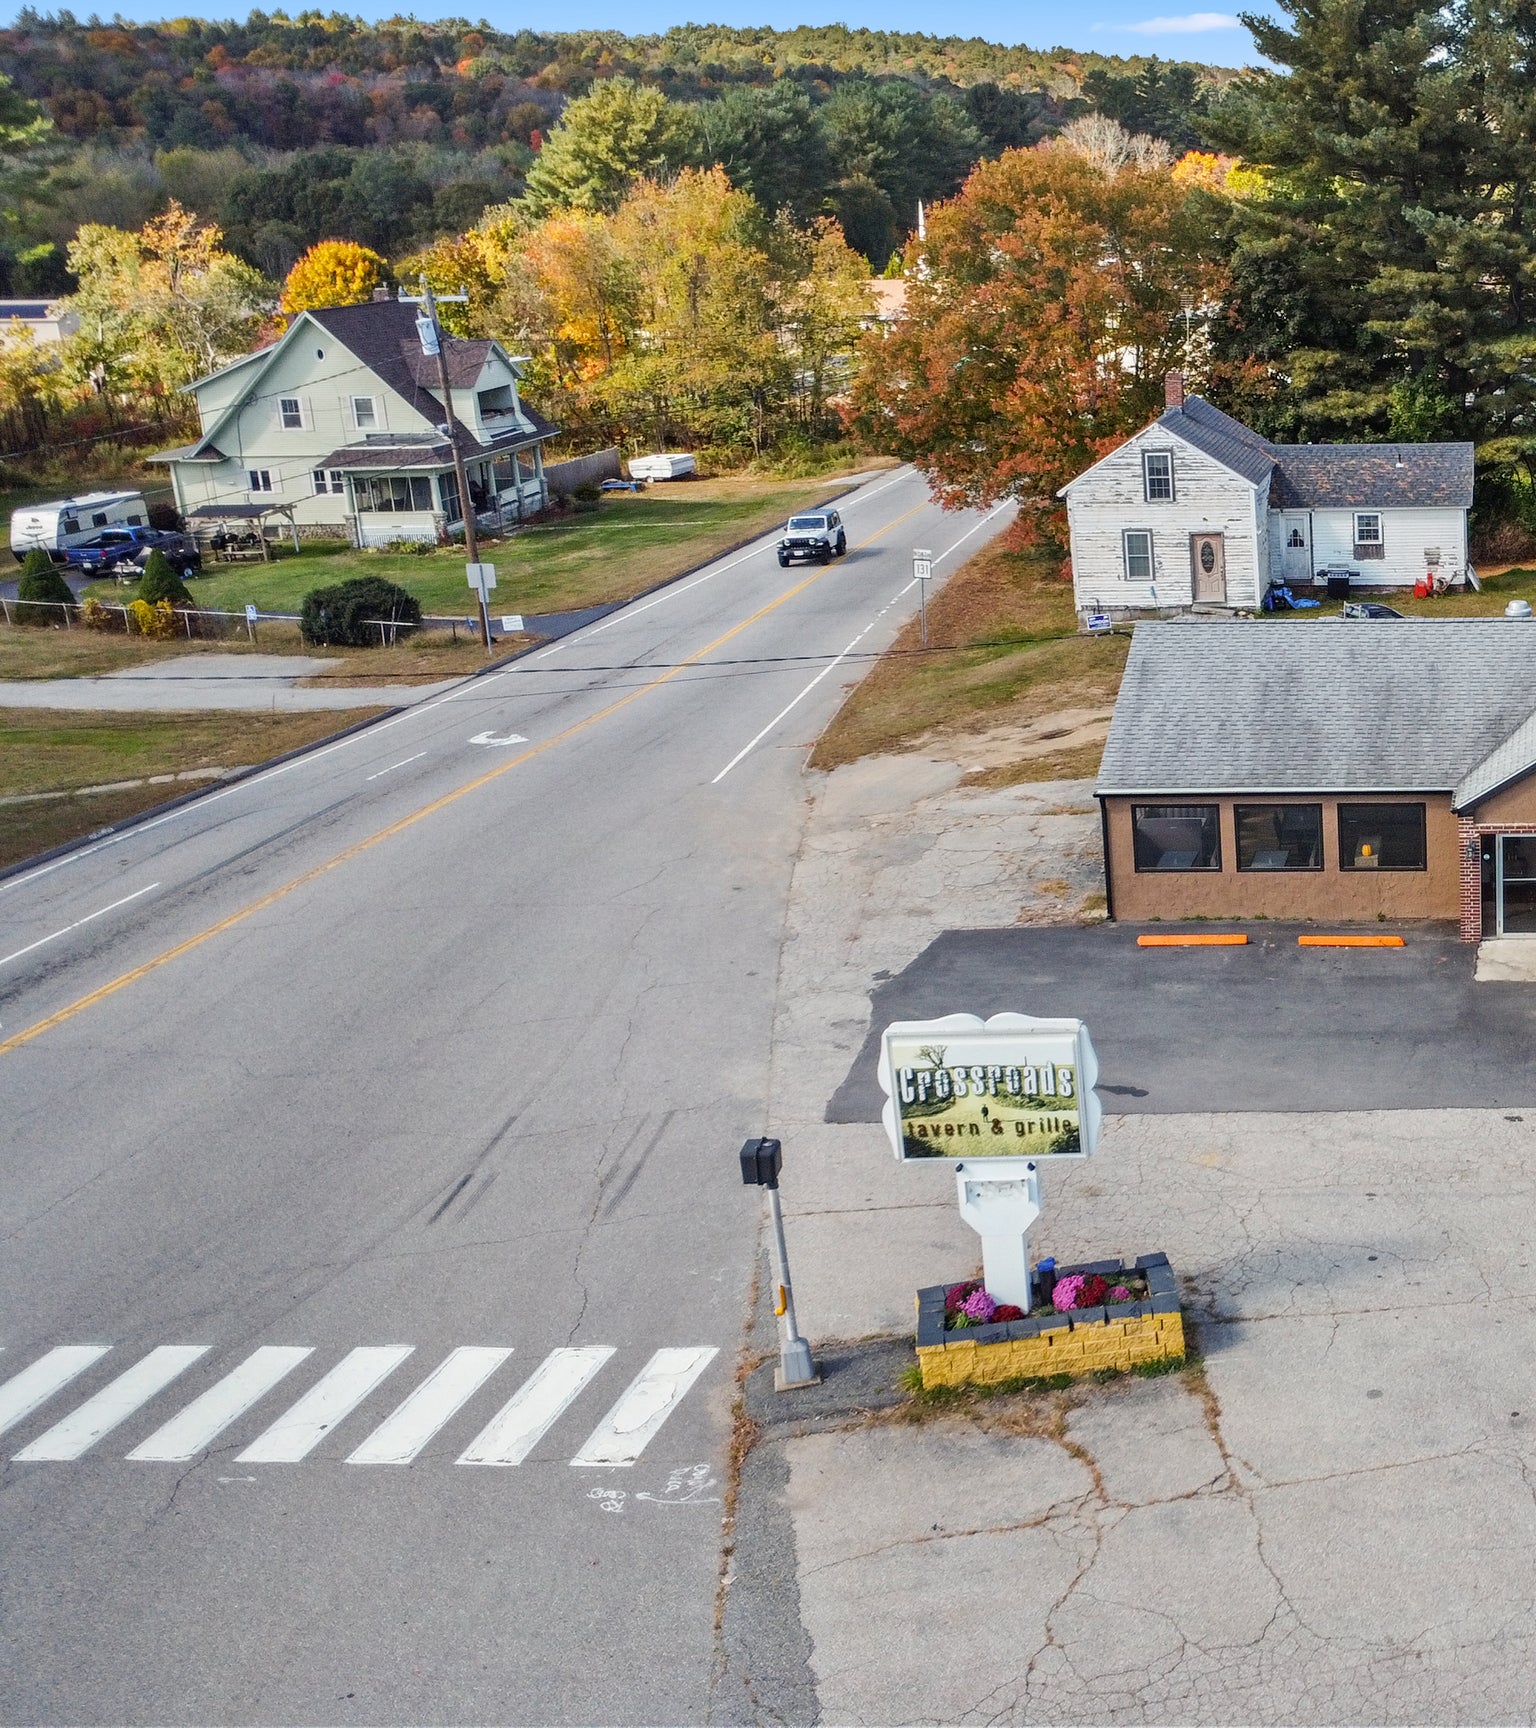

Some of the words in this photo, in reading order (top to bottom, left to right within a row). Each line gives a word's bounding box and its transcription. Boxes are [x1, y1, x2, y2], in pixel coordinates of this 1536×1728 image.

[916, 563, 929, 575] 131
[899, 1061, 1074, 1104] Crossroads
[907, 1121, 980, 1138] tavern
[991, 1118, 1004, 1136] &
[1015, 1117, 1072, 1137] grille
